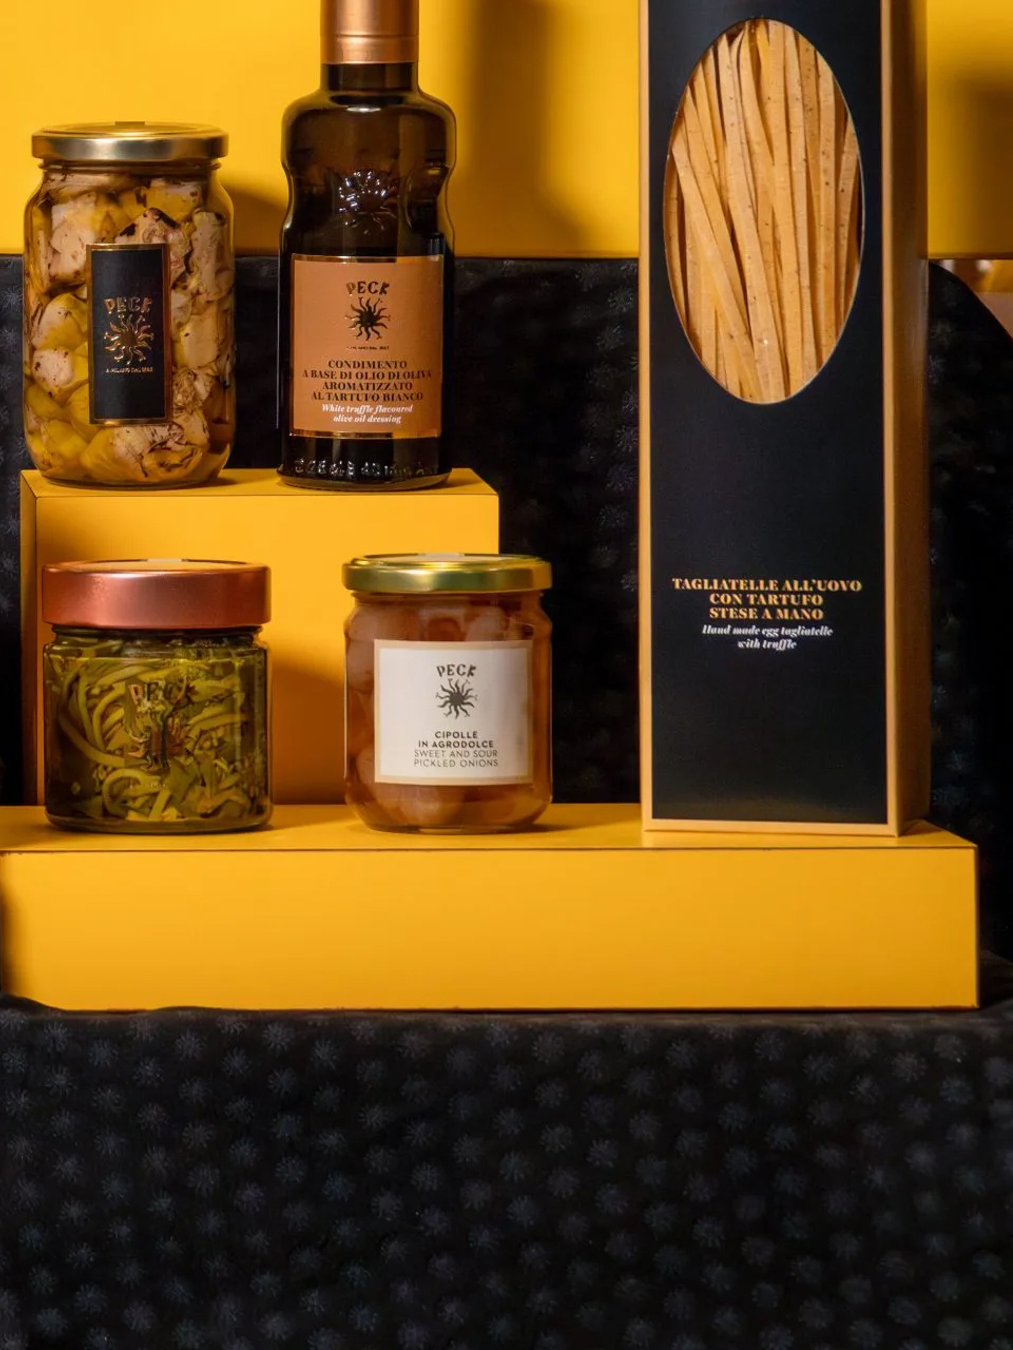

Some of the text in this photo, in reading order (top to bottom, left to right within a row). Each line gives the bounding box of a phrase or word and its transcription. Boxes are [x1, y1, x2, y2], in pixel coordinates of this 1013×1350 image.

[346, 281, 390, 296] PECK
[328, 359, 408, 369] CONDIMENTO
[311, 370, 337, 379] BASE
[340, 371, 352, 380] DI
[355, 371, 385, 380] OLIO
[388, 371, 400, 380] DI
[403, 370, 432, 380] OLIVA
[322, 381, 413, 391] AROMATIZZATO
[311, 391, 424, 402] AL TARTUFO BIANCO
[322, 403, 414, 414] White truffle flavoured
[333, 414, 402, 425] olive oil dressing
[671, 578, 779, 592] TAGLIATELLE
[709, 593, 824, 606] CON TARTUFO
[709, 607, 824, 621] STESE A MANO
[701, 624, 834, 638] Hand made egg tagliatelle
[737, 638, 798, 651] with truffle
[436, 663, 477, 678] PECK
[434, 731, 478, 739] CIPOLLE
[418, 740, 494, 748] IN AGRODOLCE
[414, 749, 498, 758] SWEET AND SOUR
[413, 759, 499, 768] PICKLED ONIONS
